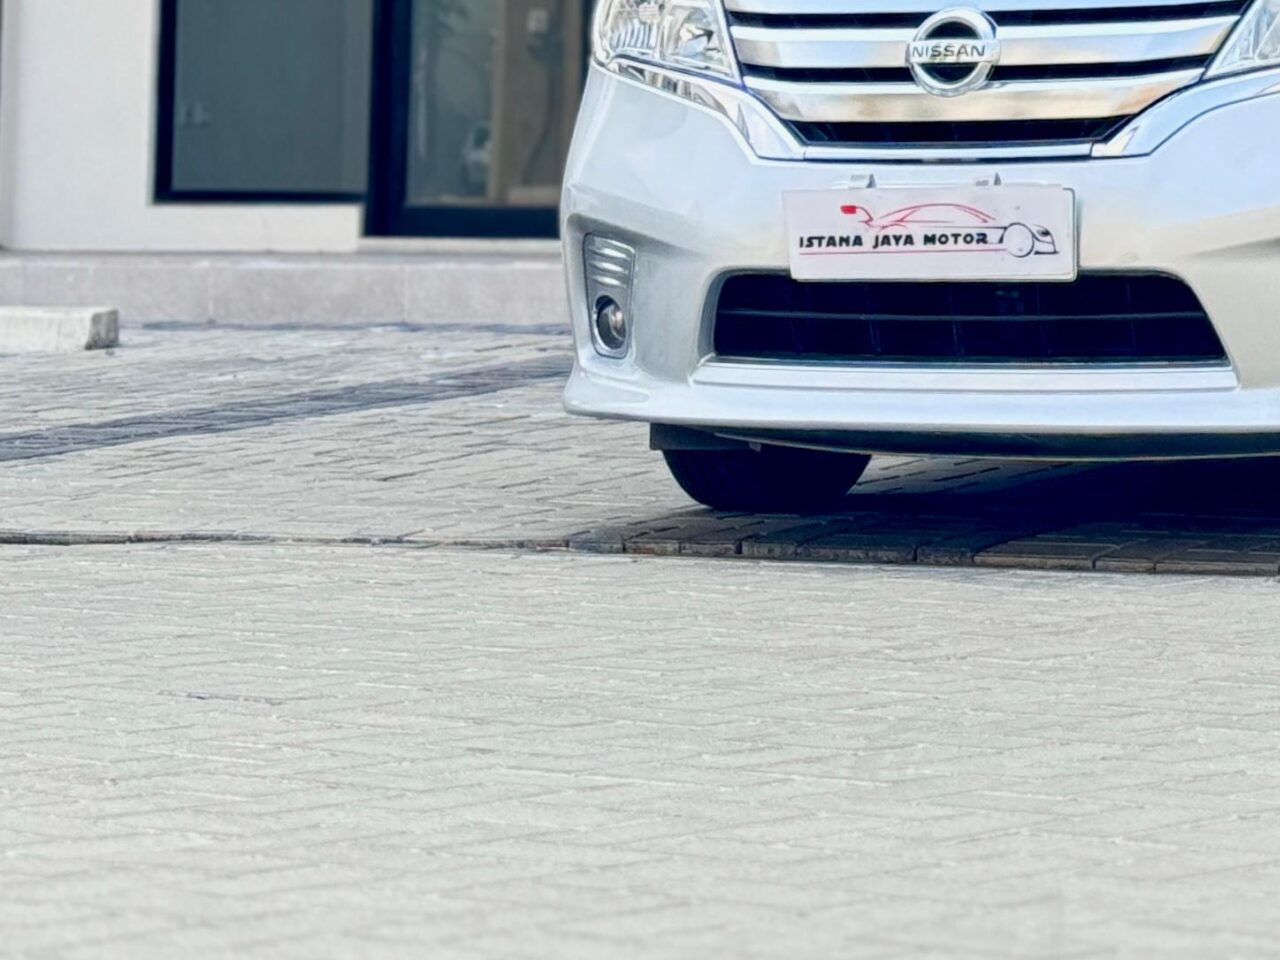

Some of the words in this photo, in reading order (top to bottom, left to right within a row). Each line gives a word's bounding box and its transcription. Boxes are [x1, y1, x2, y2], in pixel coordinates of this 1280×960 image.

[912, 43, 986, 58] NISSAN
[799, 234, 863, 248] ISTANA
[872, 233, 915, 249] JAYA
[923, 232, 989, 246] MOTOR
